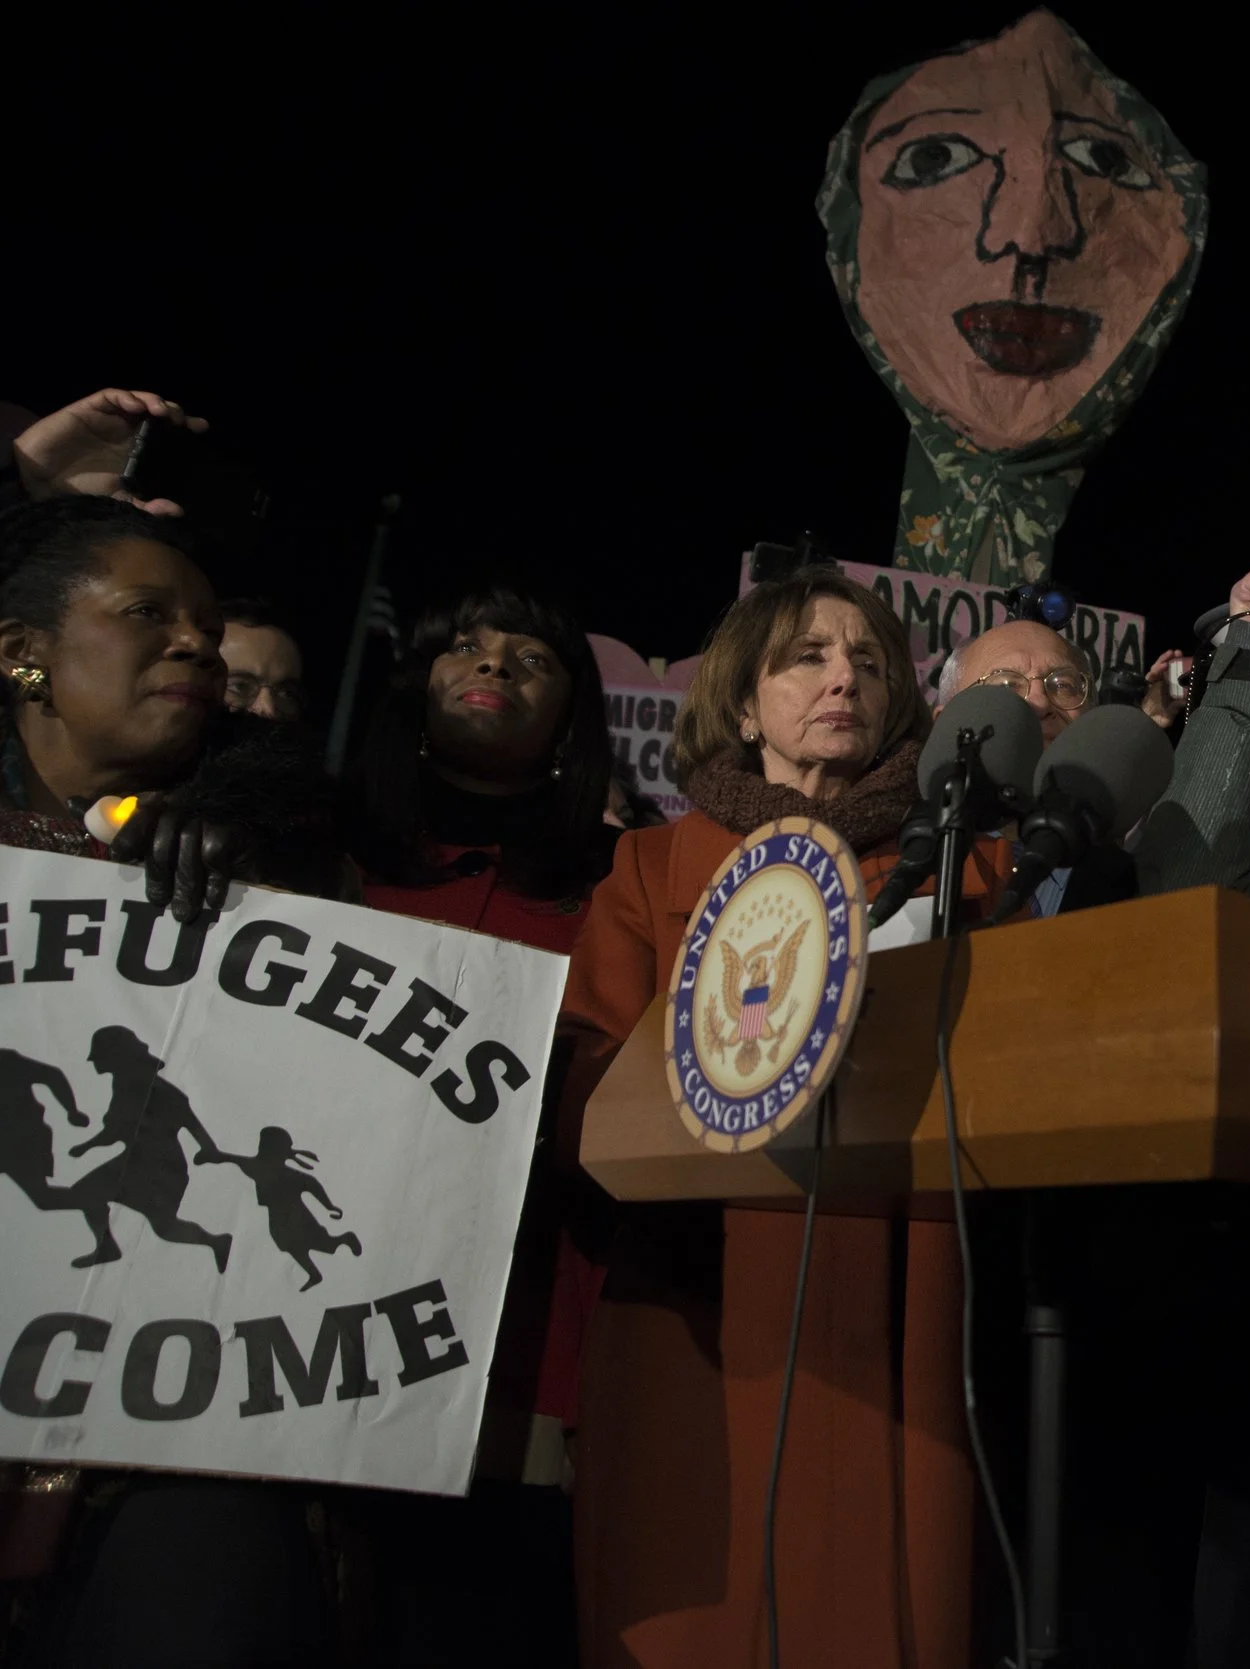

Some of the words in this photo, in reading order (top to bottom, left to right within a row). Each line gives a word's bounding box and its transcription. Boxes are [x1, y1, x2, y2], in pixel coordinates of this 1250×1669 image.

[680, 843, 767, 991] UNITED
[784, 834, 848, 962] STATES
[0, 899, 531, 1124] FUGEES
[684, 1053, 812, 1133] CONGRESS
